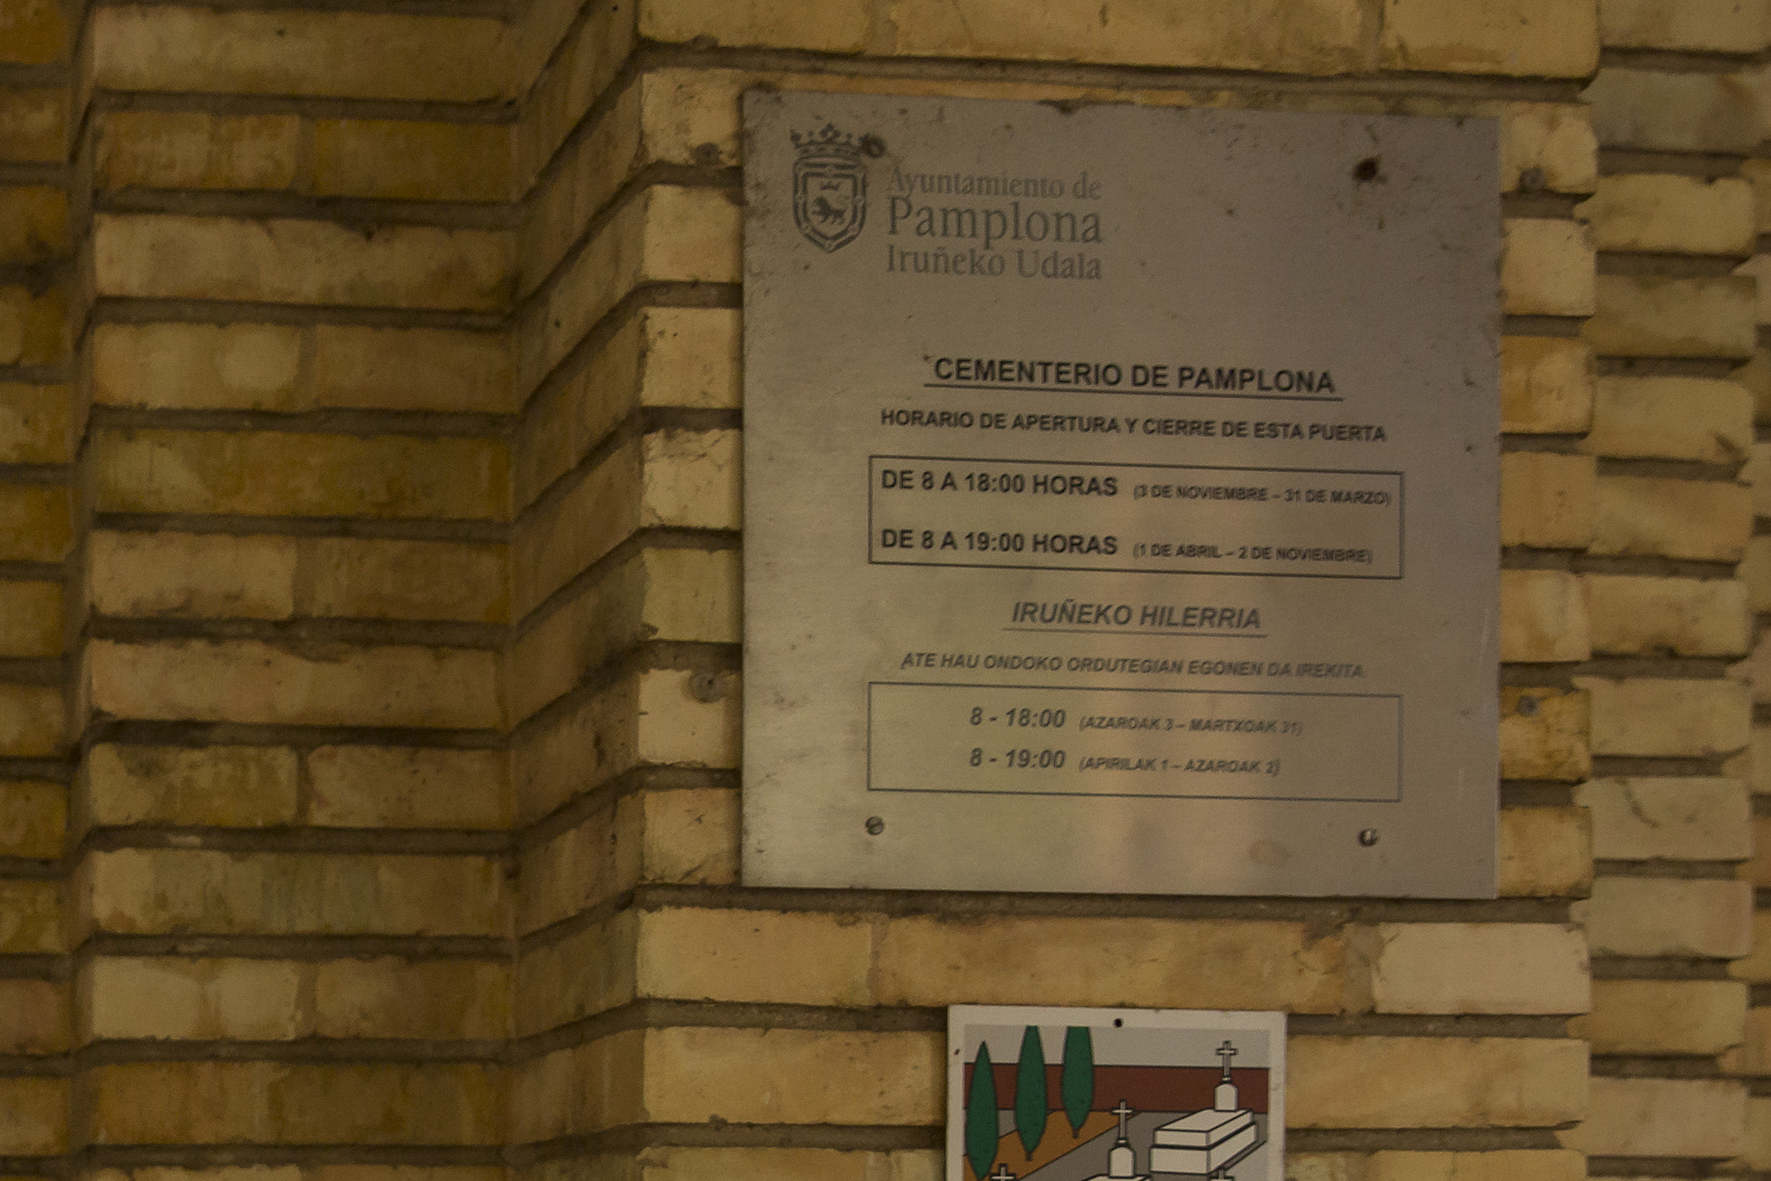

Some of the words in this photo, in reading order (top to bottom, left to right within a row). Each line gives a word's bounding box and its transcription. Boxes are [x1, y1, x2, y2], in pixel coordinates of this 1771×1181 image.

[886, 166, 1065, 199] Ayuntamiento
[1073, 171, 1103, 200] de
[887, 195, 1104, 250] Pamplona
[886, 244, 1006, 276] Iruñeko
[1017, 249, 1103, 279] Udala
[933, 357, 1123, 386] CEMENTERIO
[1131, 364, 1168, 387] DE
[1178, 366, 1336, 393] PAMPLONA
[881, 409, 974, 429] HORARIO
[979, 412, 1006, 430] DE
[1011, 413, 1120, 433] APERTURA
[1125, 418, 1138, 434] Y
[1142, 418, 1216, 437] CIERRE
[1221, 420, 1247, 438] DE
[1253, 422, 1304, 439] ESTA
[1308, 423, 1387, 442] PUERTA
[881, 470, 915, 489] DE
[921, 470, 934, 490] 8
[940, 471, 958, 491] A
[964, 472, 1025, 493] 18:00
[1032, 474, 1118, 496] HORAS
[1151, 485, 1173, 499] DE
[1177, 486, 1268, 501] NOVIEMBRE
[1284, 489, 1301, 503] 31
[1305, 489, 1326, 504] DE
[1330, 490, 1392, 507] MARZO)
[881, 529, 915, 548] DE
[921, 530, 934, 550] 8
[940, 530, 958, 550] A
[964, 532, 1025, 552] 19:00
[1032, 534, 1118, 555] HORAS
[1151, 543, 1172, 557] DE
[1175, 544, 1222, 559] ABRIL
[1238, 546, 1248, 559] 2
[1251, 547, 1271, 560] DE
[1276, 547, 1373, 565] NOVIEMBRE)
[1011, 599, 1132, 625] IRUÑEKO
[1140, 605, 1261, 628] HILERRIA
[900, 652, 937, 669] ATE
[941, 653, 980, 669] HAU
[983, 654, 1062, 671] ONDOKO
[1067, 655, 1184, 675] ORDUTEGIAN
[1187, 659, 1264, 676] EGONEN
[1267, 662, 1294, 677] DA
[970, 706, 983, 726] 8
[1005, 707, 1066, 728] 18:00
[1079, 716, 1161, 731] (AZAROAK
[969, 747, 982, 767] 8
[1005, 749, 1066, 768] 19:00
[1183, 758, 1261, 773] AZAROAK
